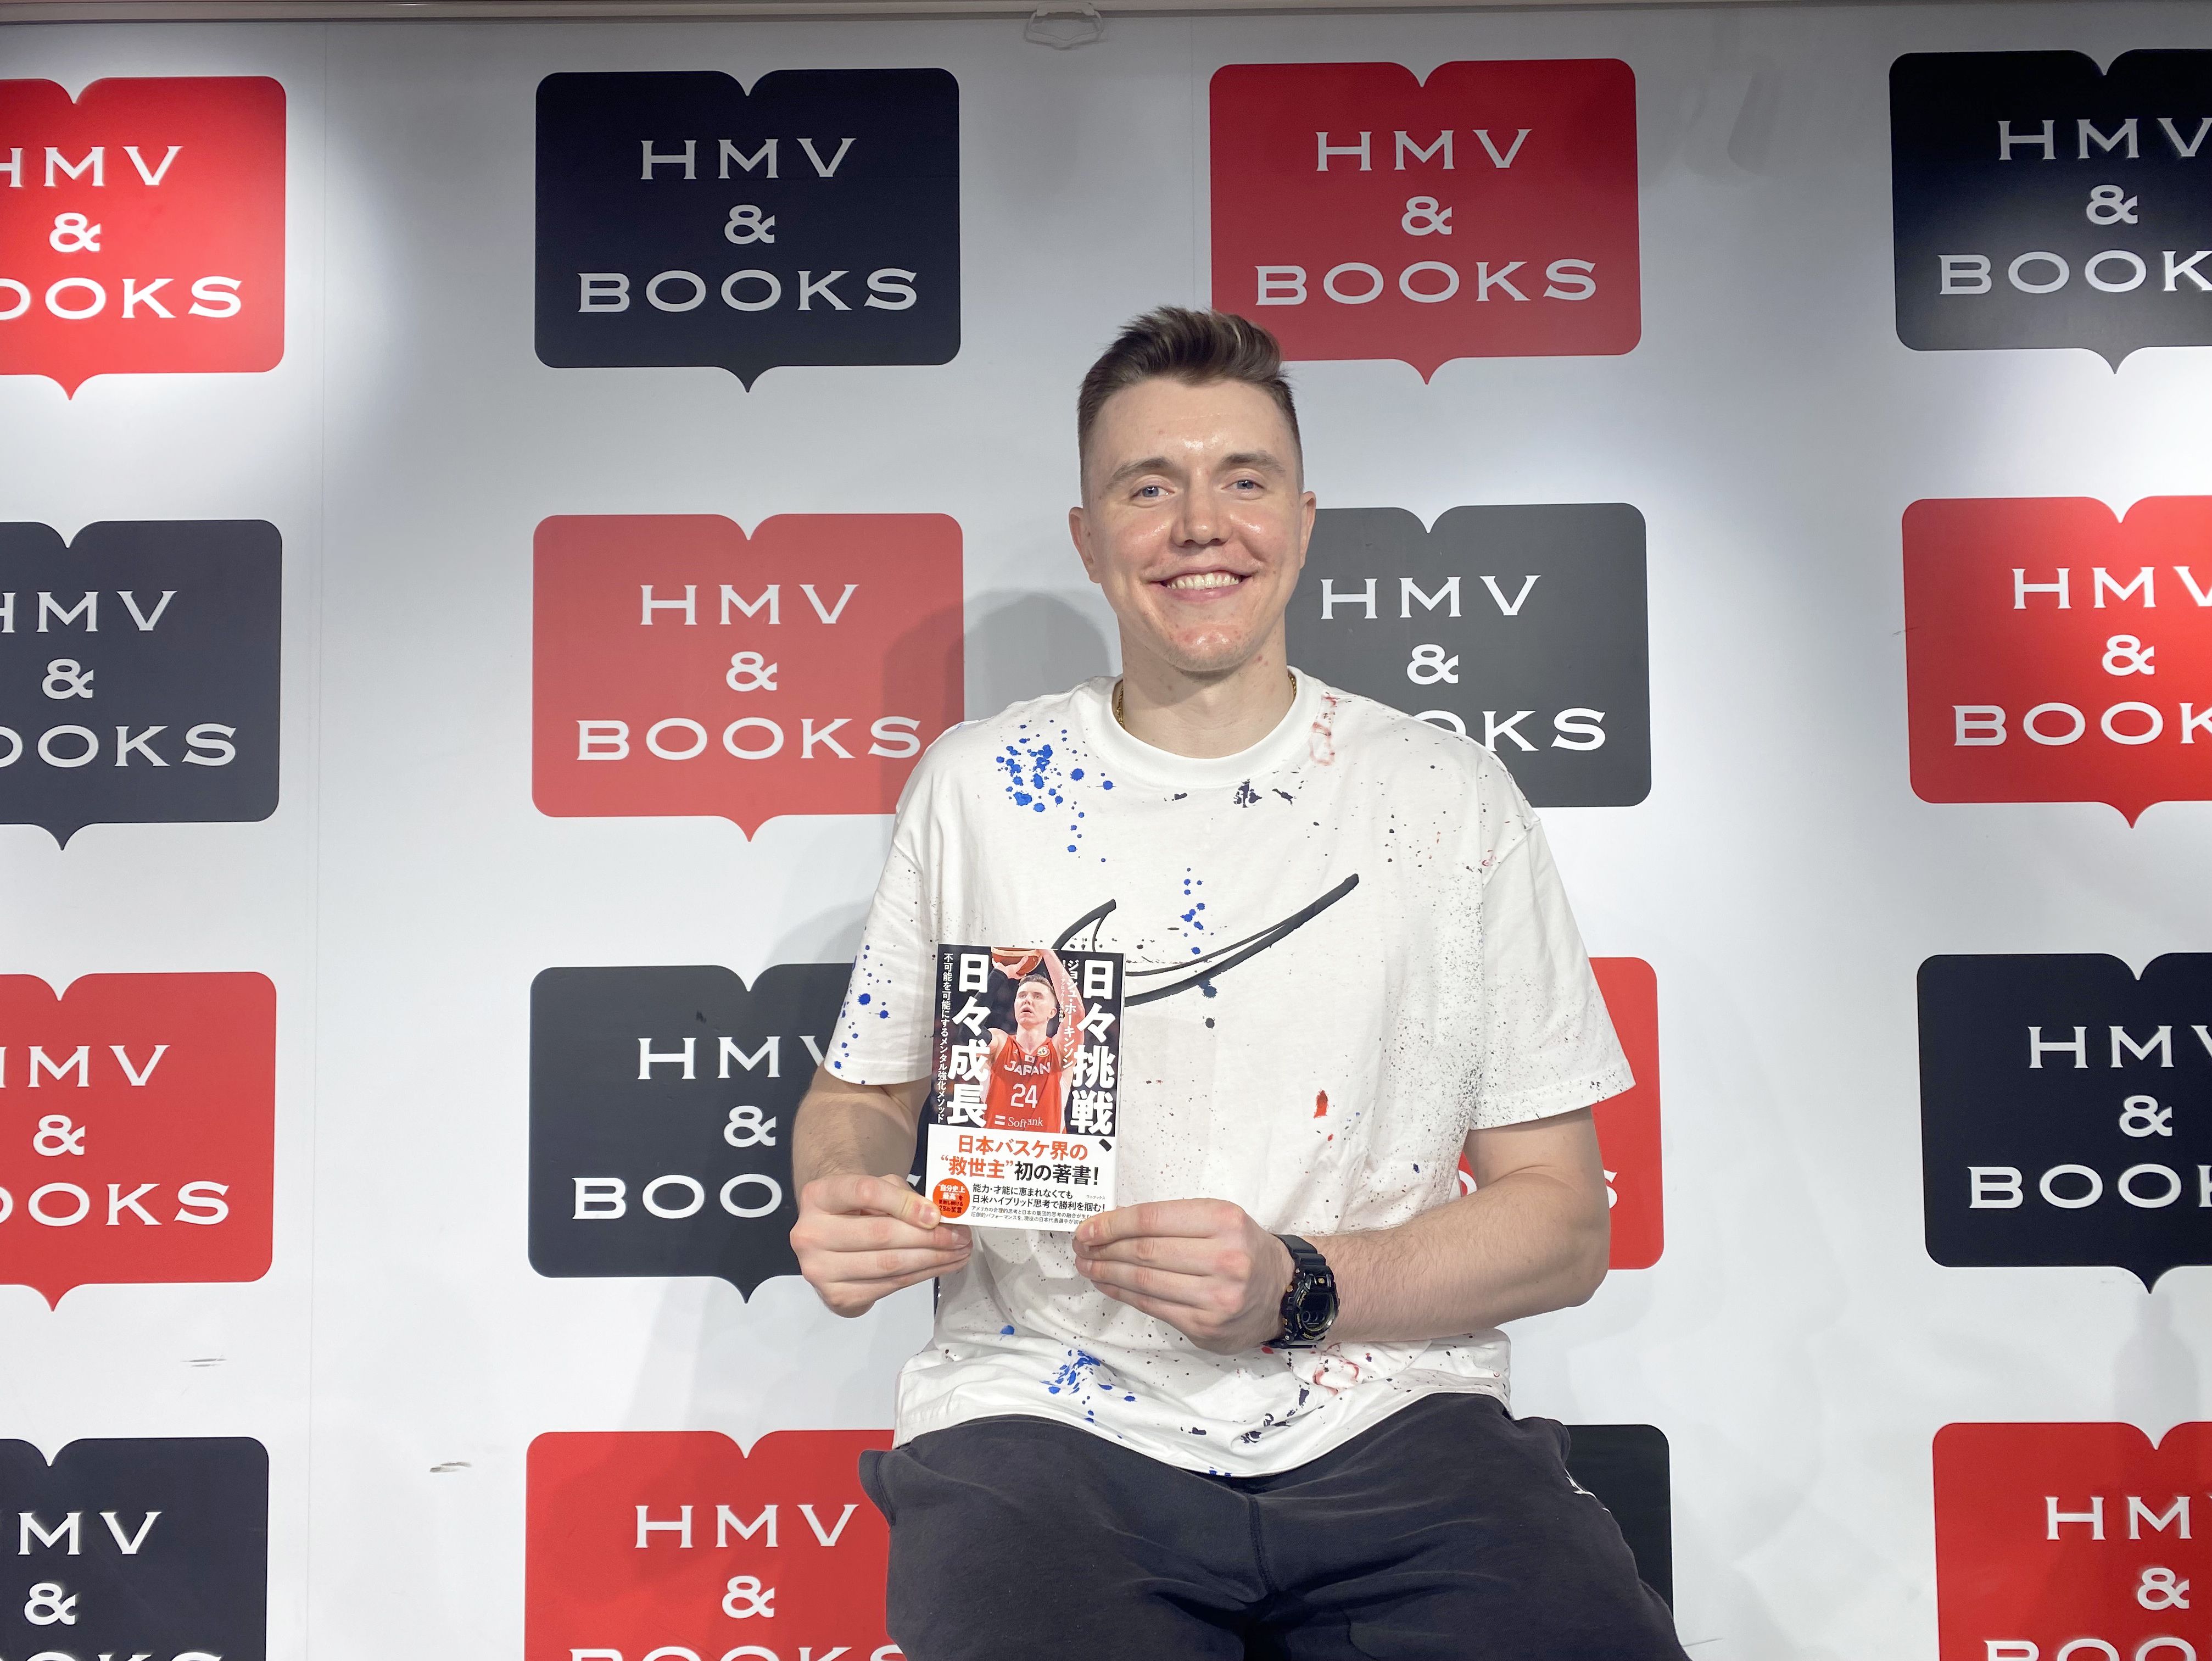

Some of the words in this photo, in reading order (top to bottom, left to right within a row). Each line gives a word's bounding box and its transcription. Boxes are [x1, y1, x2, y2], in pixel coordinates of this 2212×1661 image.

[641, 138, 856, 179] HMV
[1316, 129, 1532, 171] HMV
[1998, 118, 2212, 160] HMV
[725, 205, 775, 244] &
[1401, 196, 1452, 236] &
[2086, 185, 2138, 225] &
[49, 213, 100, 252] &
[578, 269, 917, 312] BOOKS
[1255, 259, 1596, 305] BOOKS
[1939, 250, 2212, 294] BOOK
[0, 591, 177, 633] MV
[641, 584, 858, 625] HMV
[1321, 575, 1540, 619] HMV
[727, 651, 777, 692] &
[1407, 644, 1458, 684] &
[2102, 635, 2154, 676] &
[42, 659, 93, 699] &
[577, 716, 920, 761] BOOKS
[1062, 960, 1080, 1069] ジョシュ・ホーキンソン
[937, 953, 954, 1123] 不可能を可能にするメンタル強化メソッド
[946, 954, 991, 1128] 日々成長
[1070, 960, 1116, 1152] 日々挑戦、
[0, 1045, 170, 1088] MV
[1004, 1060, 1051, 1076] JAPAN
[1010, 1083, 1038, 1108] 24
[2119, 1095, 2172, 1137] &
[33, 1115, 85, 1156] &
[724, 1106, 776, 1147] &
[1007, 1117, 1043, 1128] Softank
[958, 1134, 1088, 1161] 日本バスケ界の
[940, 1154, 1099, 1185] “救世主”初の著書!
[1968, 1164, 2212, 1208] BOO
[0, 1181, 228, 1226] OKS
[572, 1174, 781, 1219] BOO
[973, 1183, 1073, 1199] 能力・才能に恵まれなくても
[973, 1194, 1105, 1213] 日米ハイブリッド思考で勝利を掴む!
[18, 1512, 161, 1554] MV
[635, 1504, 858, 1548] HMV
[2046, 1497, 2212, 1540] HM
[25, 1583, 76, 1625] &
[722, 1576, 774, 1618] &
[2137, 1568, 2189, 1610] &
